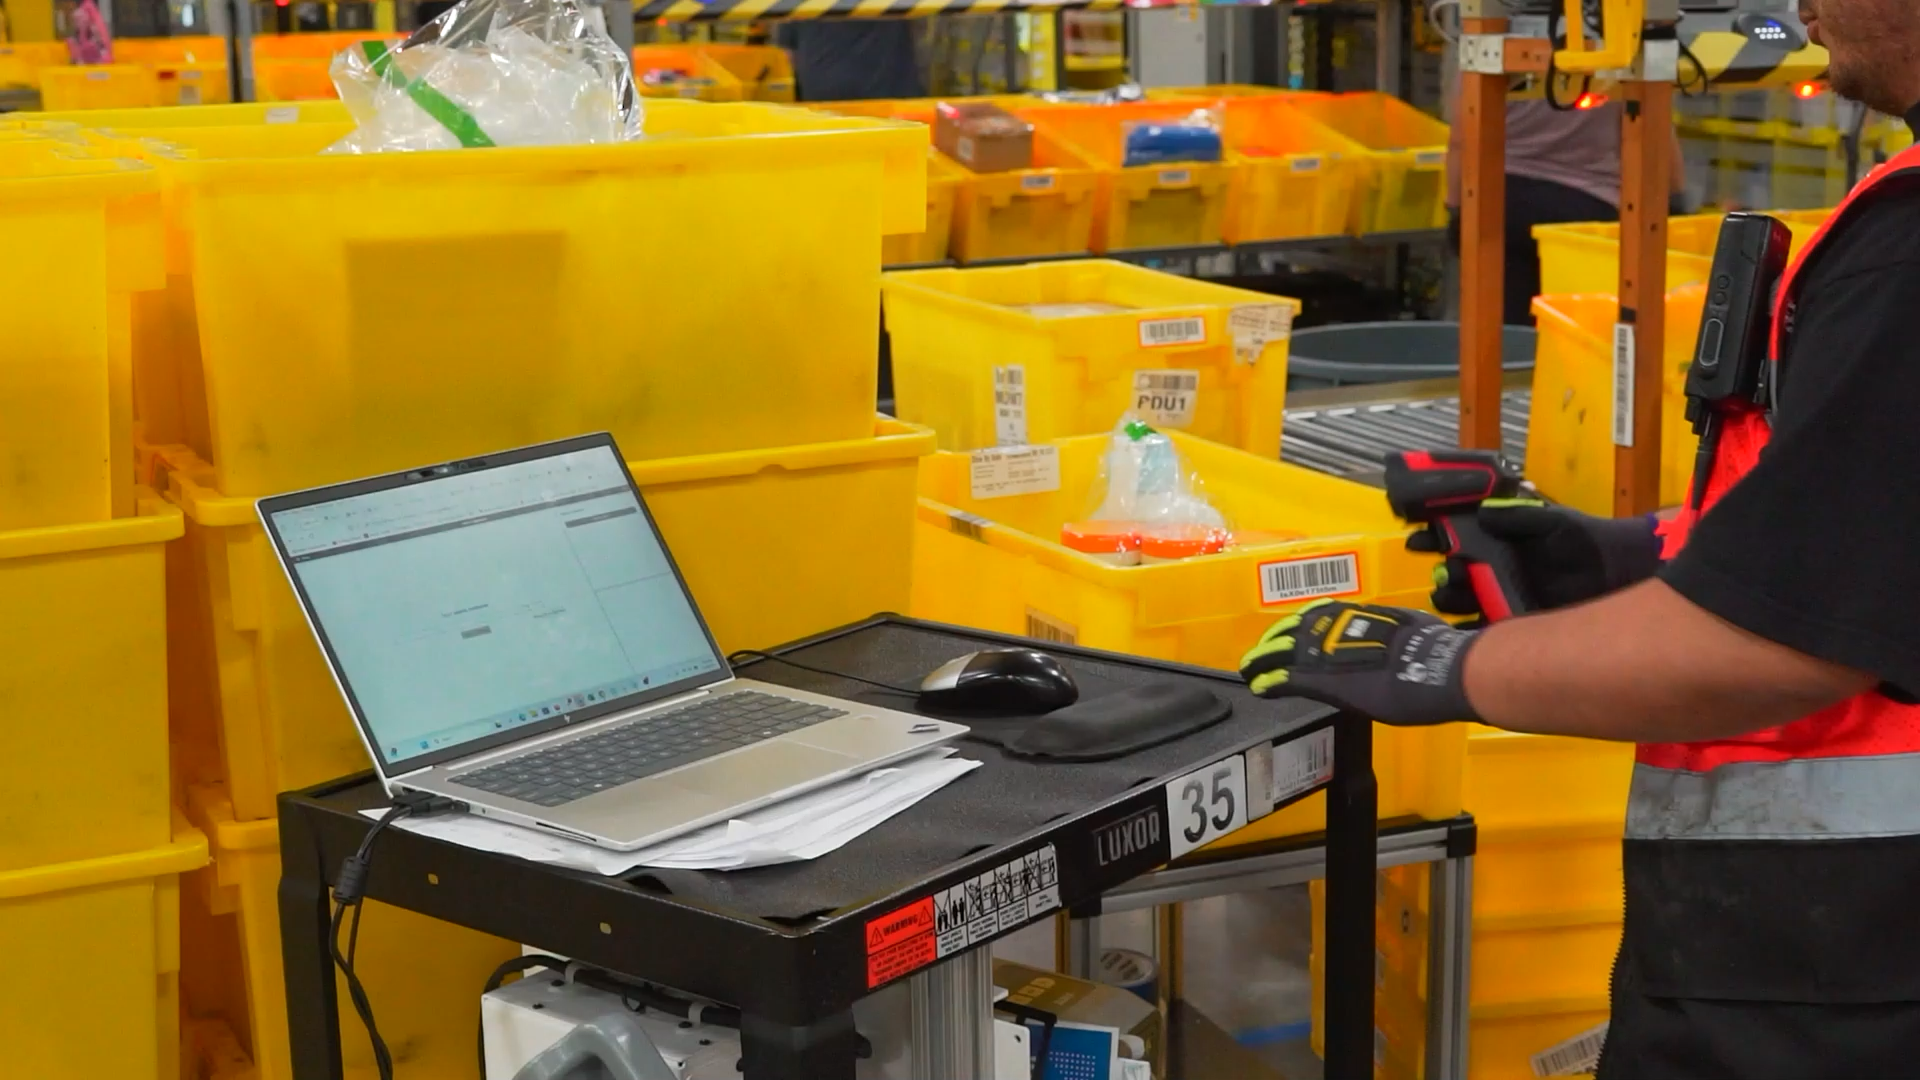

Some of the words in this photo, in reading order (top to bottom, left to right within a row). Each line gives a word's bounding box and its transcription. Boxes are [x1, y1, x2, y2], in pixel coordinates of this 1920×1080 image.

[1182, 767, 1235, 844] 35
[1097, 811, 1160, 866] LUXOR
[883, 913, 918, 936] WARNING
